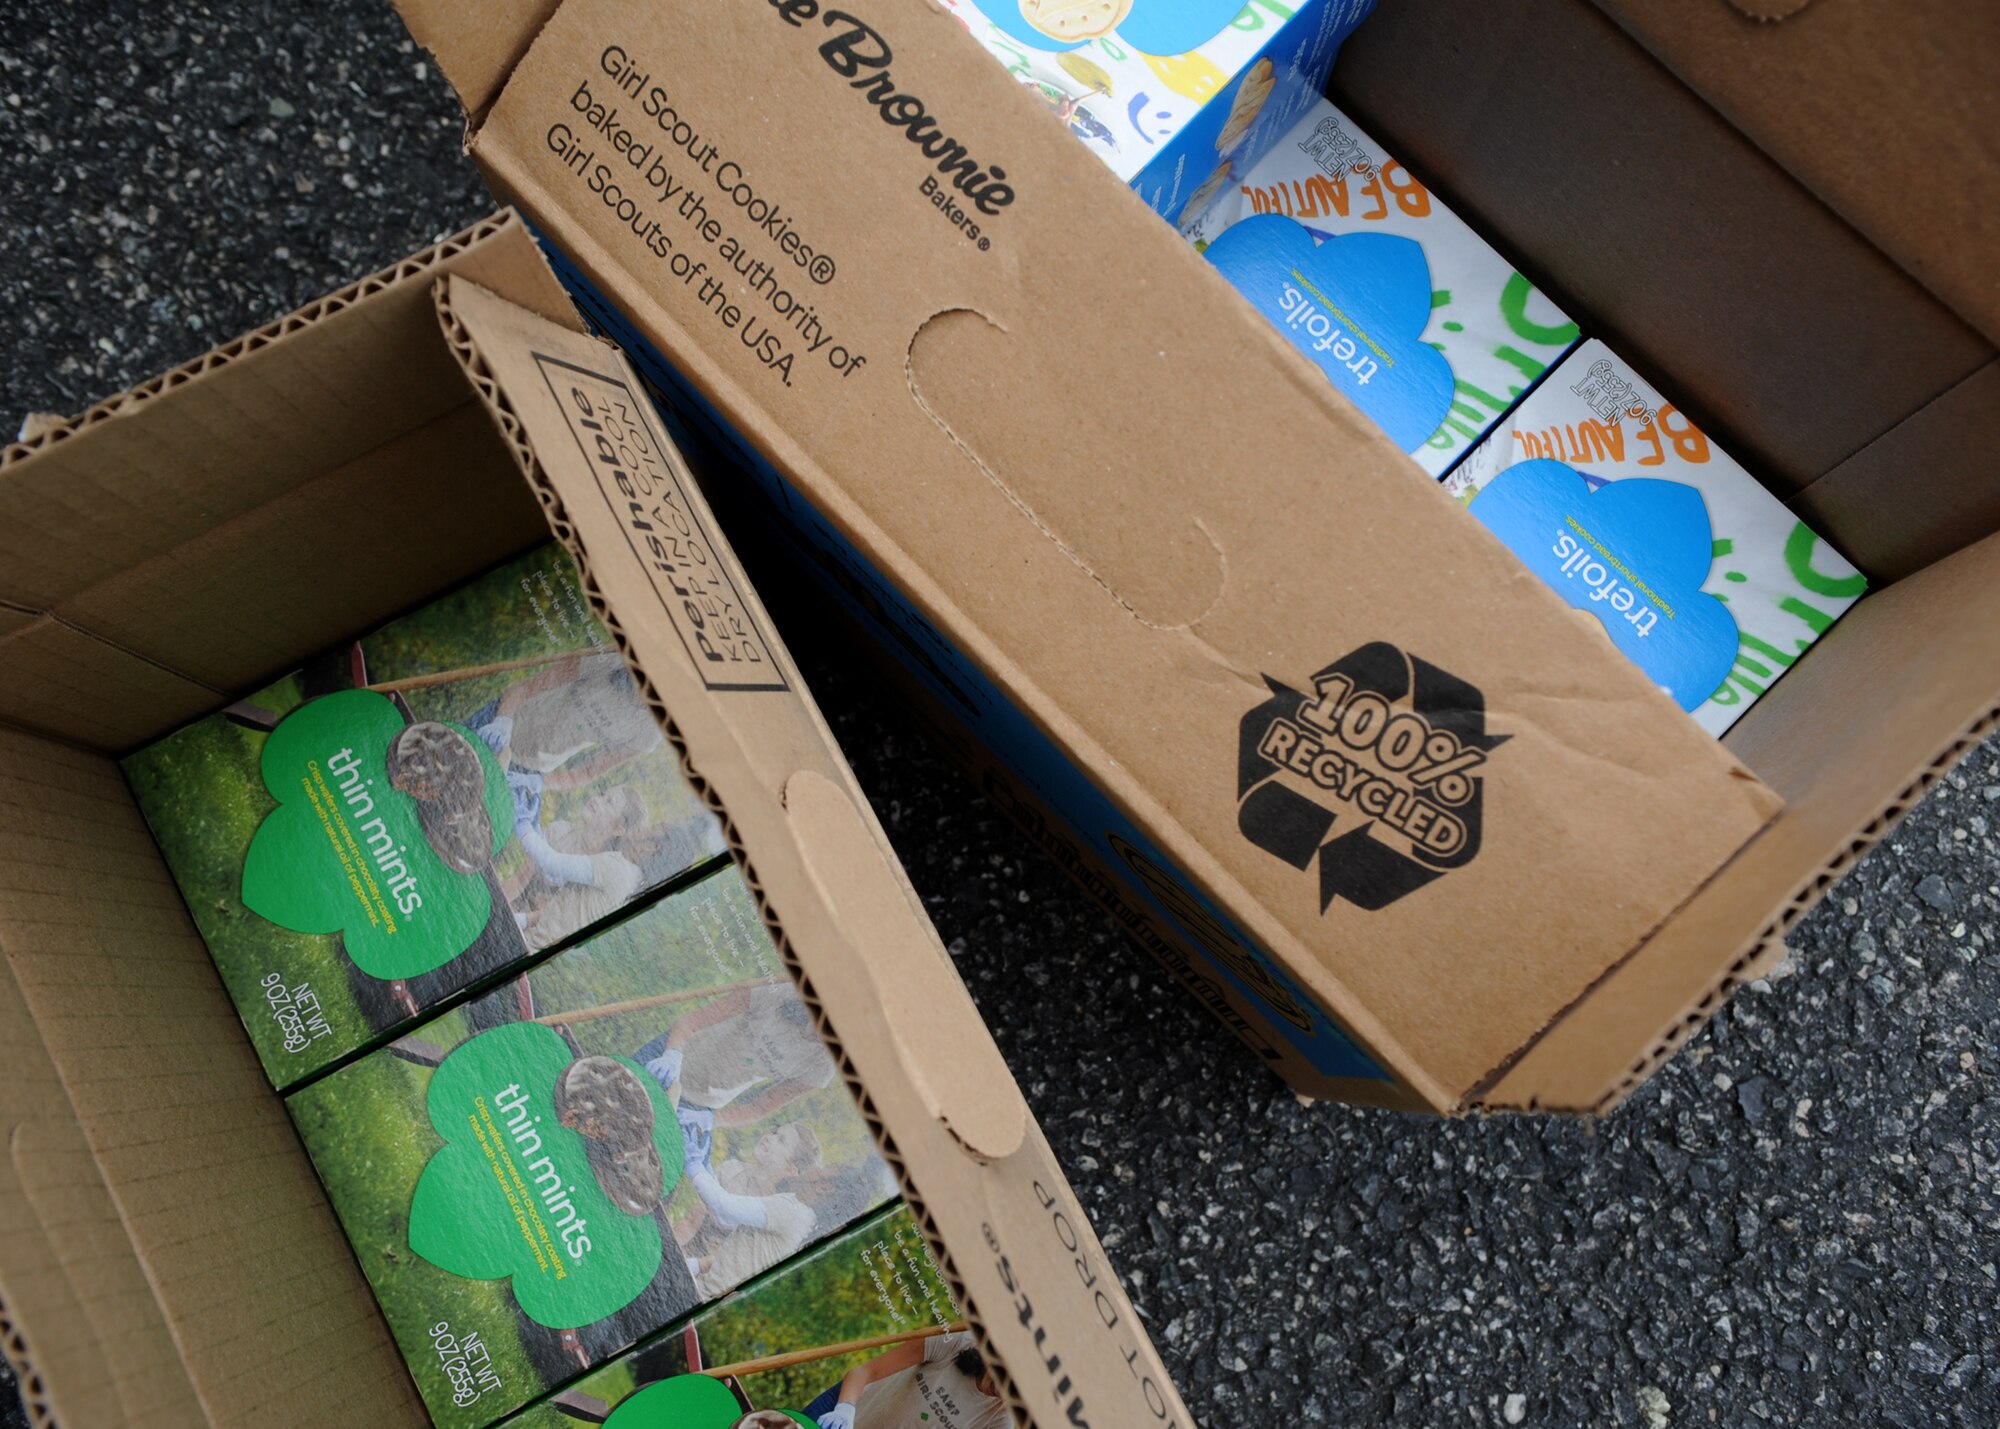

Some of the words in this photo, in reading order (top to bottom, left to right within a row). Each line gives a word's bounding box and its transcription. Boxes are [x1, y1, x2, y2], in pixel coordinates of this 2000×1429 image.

[818, 9, 1015, 215] Brownie
[600, 45, 649, 99] Girl
[643, 86, 720, 173] Scout
[716, 161, 836, 285] Cookies®
[570, 80, 658, 168] baked
[645, 154, 684, 202] by
[678, 189, 722, 243] the
[719, 238, 833, 352] authority
[828, 345, 867, 377] of
[546, 122, 595, 177] Girl
[587, 164, 673, 258] Scouts
[670, 252, 708, 286] of
[697, 275, 742, 327] the
[740, 315, 795, 387] USA.
[1317, 294, 1358, 333] shortbread
[1357, 330, 1394, 366] Traditional
[598, 396, 652, 496] COOL
[614, 401, 721, 586] LOCATION
[572, 387, 725, 662] Perishable
[651, 507, 670, 528] A
[664, 535, 692, 568] IN
[1594, 541, 1637, 583] shortbread
[688, 576, 742, 662] KEEP
[1635, 578, 1676, 619] Traditional
[724, 595, 761, 663] DRY
[1296, 672, 1487, 806] 100%
[306, 761, 324, 784] Crisp
[327, 747, 373, 818] thin
[1258, 716, 1467, 857] RECYCLED
[318, 783, 339, 812] wafers
[301, 777, 320, 803] made
[315, 803, 329, 822] with
[323, 822, 344, 852] natural
[339, 853, 348, 863] oil
[345, 864, 354, 874] of
[332, 813, 356, 848] covered
[351, 848, 360, 857] in
[352, 857, 383, 900] chocolaty
[373, 900, 397, 933] coating
[291, 982, 322, 1019] NET
[305, 1010, 333, 1039] WT
[467, 1115, 487, 1141] made
[472, 1096, 491, 1121] Crisp
[495, 1083, 542, 1157] thin
[481, 1141, 496, 1160] with
[485, 1121, 506, 1151] wafers
[490, 1161, 512, 1193] natural
[499, 1152, 525, 1189] covered
[507, 1193, 516, 1204] oil
[512, 1205, 522, 1215] of
[519, 1189, 528, 1197] in
[520, 1198, 551, 1243] chocolaty
[911, 1222, 924, 1239] our
[515, 1216, 551, 1271] peppermint.
[541, 1243, 567, 1279] coating
[860, 1250, 872, 1267] for
[1033, 1180, 1118, 1329] DROP
[873, 1240, 895, 1270] place
[893, 1271, 902, 1284] to
[900, 1284, 912, 1305] live
[894, 1229, 905, 1247] be
[902, 1248, 909, 1256] a
[907, 1256, 920, 1277] fun
[918, 1279, 935, 1299] and
[930, 1299, 953, 1343] healthy
[460, 1331, 490, 1366] NET
[475, 1363, 502, 1393] WT
[1119, 1345, 1177, 1429] OT
